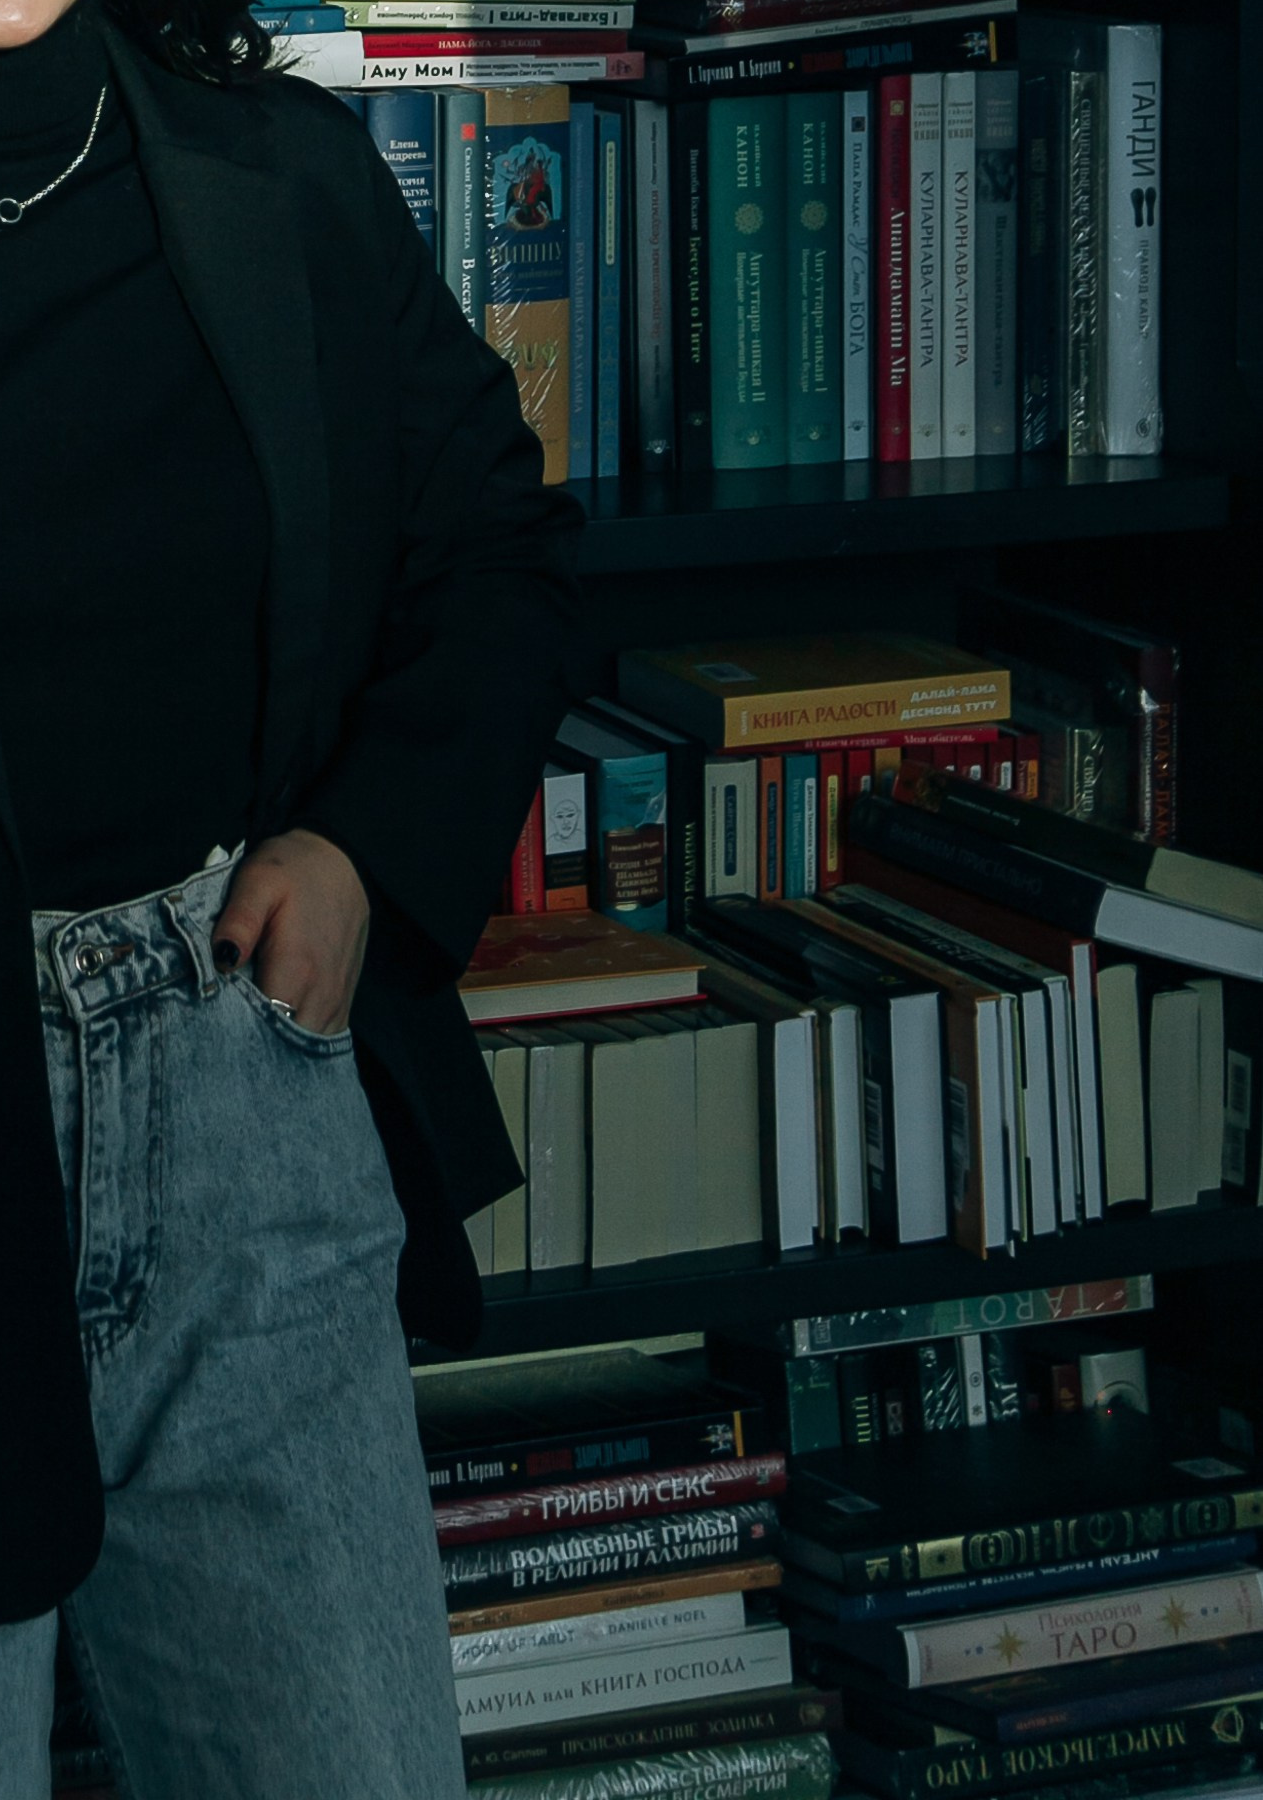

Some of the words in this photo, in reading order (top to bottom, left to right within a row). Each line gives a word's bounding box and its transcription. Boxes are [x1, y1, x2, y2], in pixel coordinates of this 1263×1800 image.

[371, 64, 407, 81] Аму
[416, 63, 454, 78] Мом
[1126, 80, 1157, 177] ГАНДИ
[752, 709, 811, 732] КНИГА
[542, 1486, 624, 1520] ГРИБЫ
[633, 1482, 649, 1508] И
[656, 1474, 717, 1505] СЕКС
